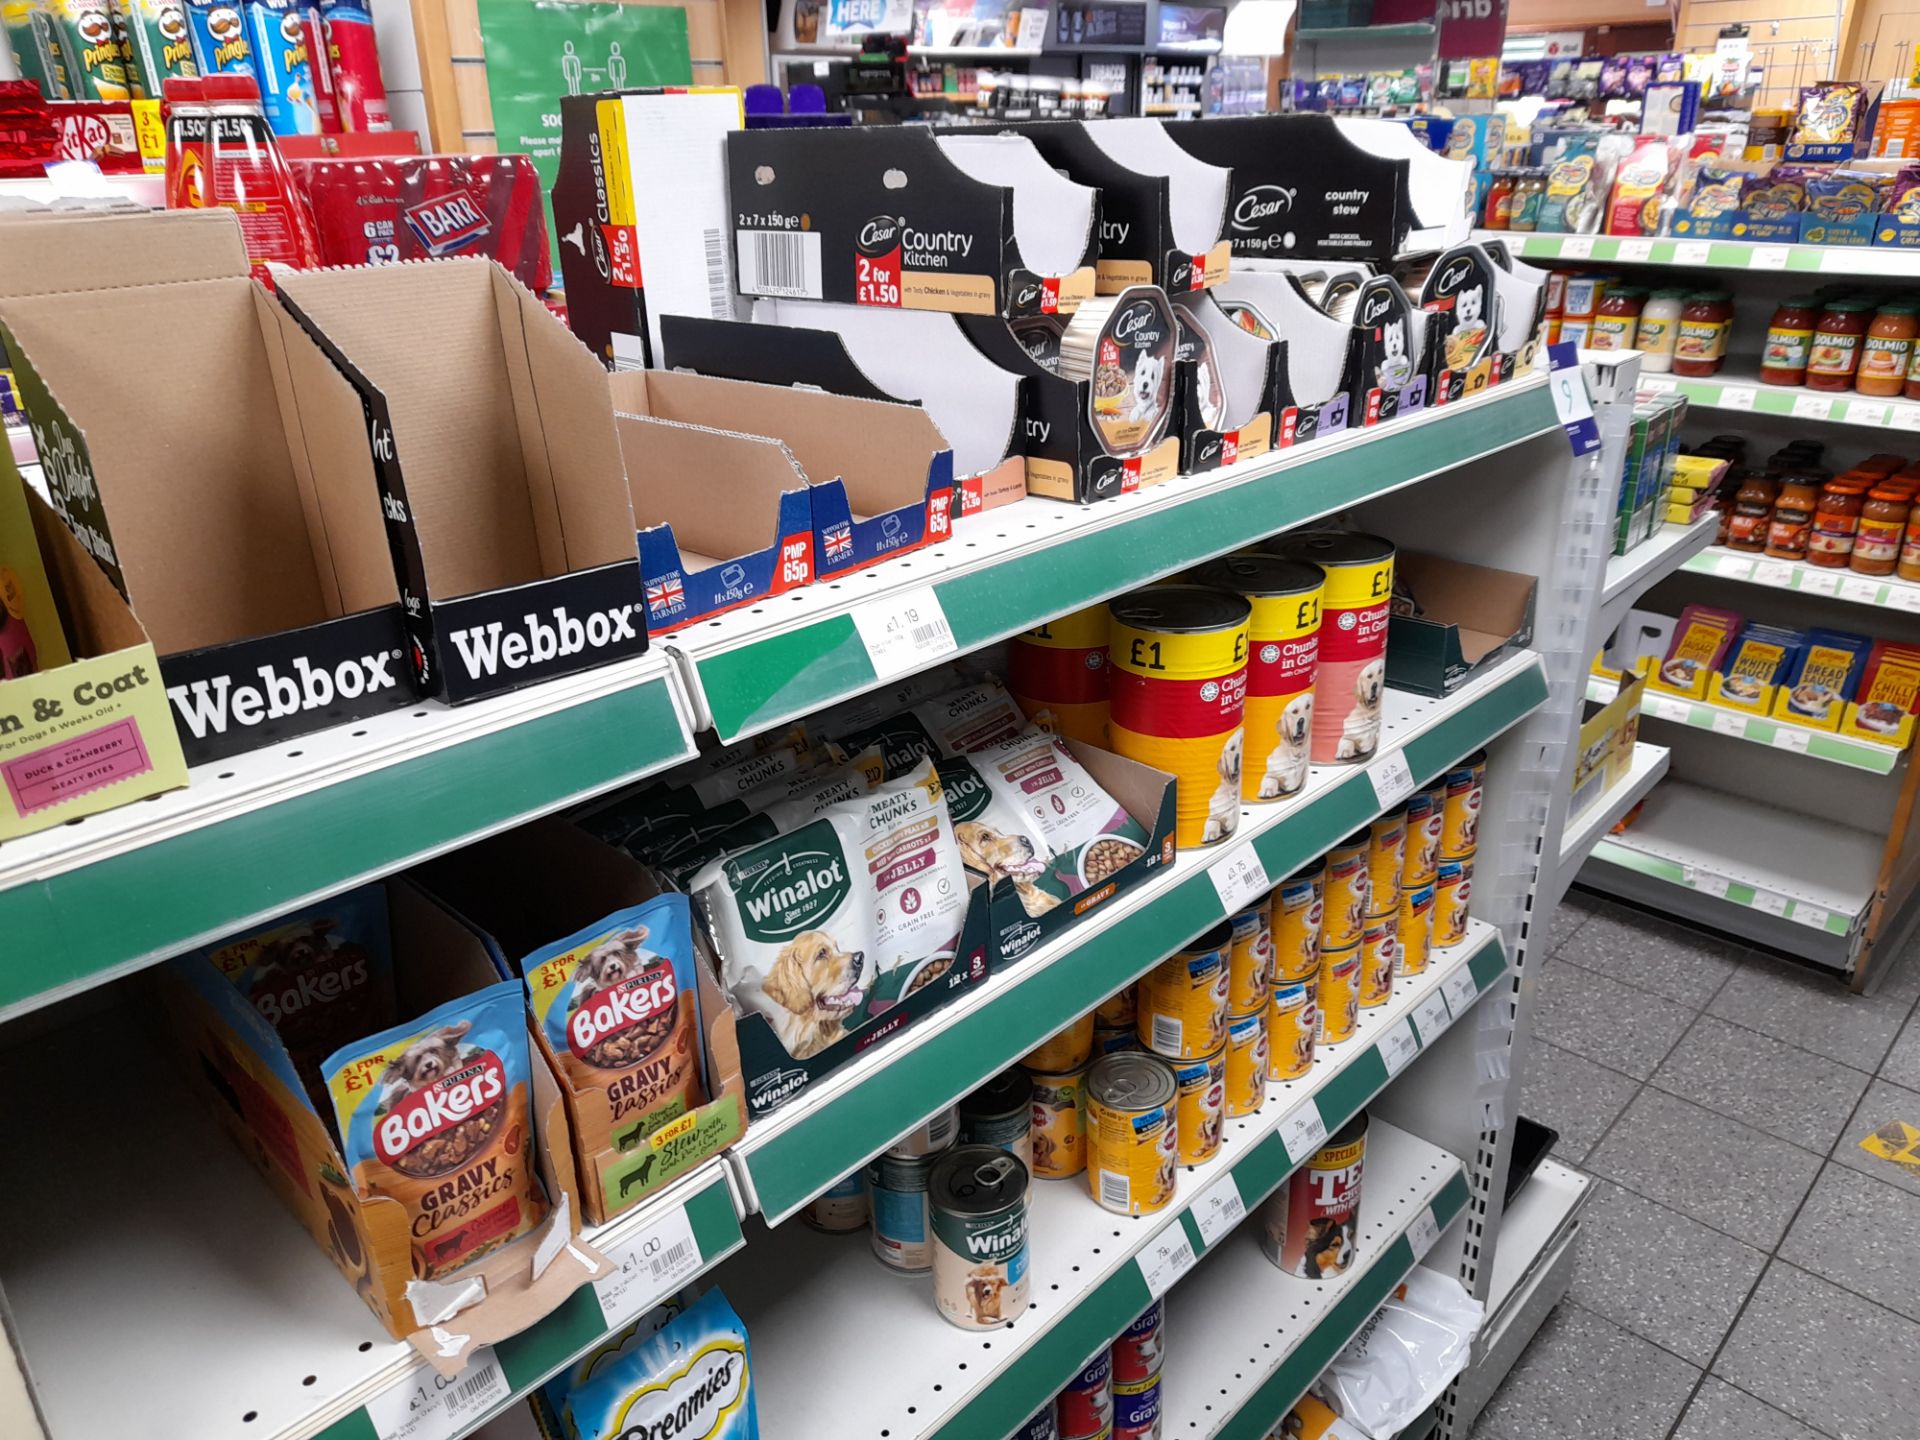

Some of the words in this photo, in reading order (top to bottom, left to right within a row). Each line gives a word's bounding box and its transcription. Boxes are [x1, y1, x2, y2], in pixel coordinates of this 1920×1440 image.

[838, 1, 881, 20] HERE
[142, 112, 149, 126] 3
[142, 134, 158, 149] £1
[520, 137, 546, 146] Please
[1808, 146, 1827, 156] STIR
[1829, 147, 1843, 156] FRY
[533, 148, 555, 157] apart
[589, 132, 609, 222] Classics
[1325, 189, 1370, 204] country
[419, 197, 480, 237] BARR
[739, 213, 745, 226] 2
[746, 216, 752, 226] x
[753, 214, 759, 226] 7
[760, 216, 766, 226] x
[1234, 195, 1284, 224] Cesar
[1333, 203, 1360, 216] stew
[363, 222, 376, 238] 6
[860, 222, 896, 247] Cesar
[613, 240, 622, 263] for
[902, 229, 973, 257] Country
[618, 229, 634, 283] £1.50
[903, 252, 948, 267] Kitchen
[613, 270, 624, 281] 2
[859, 259, 870, 282] 2
[873, 268, 890, 283] for
[1191, 264, 1198, 275] 2
[1438, 260, 1471, 295] Cesar
[859, 284, 898, 304] £1.50
[924, 286, 945, 295] Chicken
[1042, 287, 1048, 298] 2
[1365, 296, 1391, 324] Cesar
[1115, 309, 1151, 338] Cesar
[1103, 342, 1108, 352] 2
[1134, 330, 1160, 343] Country
[1814, 334, 1856, 348] DOLMIO
[1866, 338, 1908, 352] DOLMIO
[1223, 441, 1229, 451] 2
[1121, 477, 1140, 488] £1.50
[1122, 468, 1129, 481] 2
[930, 494, 949, 514] PMP
[961, 497, 981, 512] £1.50
[962, 488, 969, 501] 2
[969, 491, 977, 500] for
[821, 519, 850, 537] SUPPORTING
[930, 512, 949, 535] 65p
[784, 541, 807, 562] PMP
[827, 547, 854, 566] FARMERS
[644, 570, 680, 587] SUPPORTING
[784, 560, 809, 584] 65p
[1371, 567, 1391, 597] £1
[653, 602, 687, 621] FARMERS
[1296, 597, 1318, 629] £1
[1358, 625, 1370, 636] in
[450, 604, 636, 680] Webbox
[1130, 637, 1166, 670] £1
[1282, 658, 1295, 669] in
[1733, 666, 1771, 681] SAUCE
[1738, 658, 1774, 672] WHITE
[1806, 665, 1844, 679] BREAD
[1802, 674, 1841, 690] SAUCE
[1874, 681, 1916, 697] CHILLI
[33, 698, 64, 723] &
[74, 665, 149, 706] Coat
[167, 650, 396, 739] Webbox
[1221, 694, 1232, 706] in
[949, 694, 988, 718] CHUNKS
[20, 730, 47, 744] Dogs
[50, 726, 57, 734] 8
[60, 715, 94, 730] Weeks
[96, 706, 114, 717] Old
[25, 765, 54, 780] DUCK
[57, 761, 63, 769] &
[65, 738, 124, 765] CRANBERRY
[737, 754, 776, 775] MEATY
[52, 773, 84, 791] MEATY
[87, 764, 114, 779] BITES
[737, 760, 785, 790] CHUNKS
[1038, 772, 1056, 786] JELLY
[816, 780, 849, 801] MEATY
[871, 791, 908, 815] MEATY
[870, 800, 917, 829] CHUNKS
[903, 824, 920, 838] PEAS
[895, 838, 924, 855] CARROTS
[763, 871, 784, 886] FEEDING
[890, 856, 927, 881] JELLY
[746, 858, 843, 923] Winalot
[1086, 887, 1112, 907] GRAVY
[784, 907, 801, 925] Since
[802, 899, 817, 914] 1927
[897, 917, 919, 931] GRAIN
[920, 910, 935, 922] FREE
[232, 939, 259, 955] FOR
[1000, 925, 1041, 956] Winalot
[221, 953, 248, 972] £1
[540, 964, 549, 975] 3
[551, 954, 575, 970] FOR
[973, 955, 981, 969] 3
[542, 968, 567, 989] £1
[623, 971, 663, 991] PURINA
[256, 959, 368, 1025] Bakers
[572, 974, 675, 1048] Bakers
[871, 1018, 899, 1042] JELLY
[341, 1066, 352, 1079] 3
[353, 1055, 385, 1075] FOR
[441, 1063, 485, 1089] PURINA
[344, 1072, 373, 1094] £1
[607, 1056, 672, 1102] GRAVY
[751, 1071, 809, 1109] Winalot
[380, 1066, 502, 1156] Bakers
[655, 1135, 664, 1146] 3
[664, 1127, 679, 1140] FOR
[680, 1118, 692, 1131] £1
[660, 1129, 700, 1166] Stew
[1323, 1146, 1357, 1162] SPECIAL
[421, 1157, 500, 1211] GRAVY
[412, 1166, 515, 1239] Classics
[1325, 1203, 1349, 1216] WITH
[622, 1237, 661, 1274] £1.00
[616, 1356, 734, 1440] Dreamies
[1030, 1418, 1051, 1437] GRAIN
